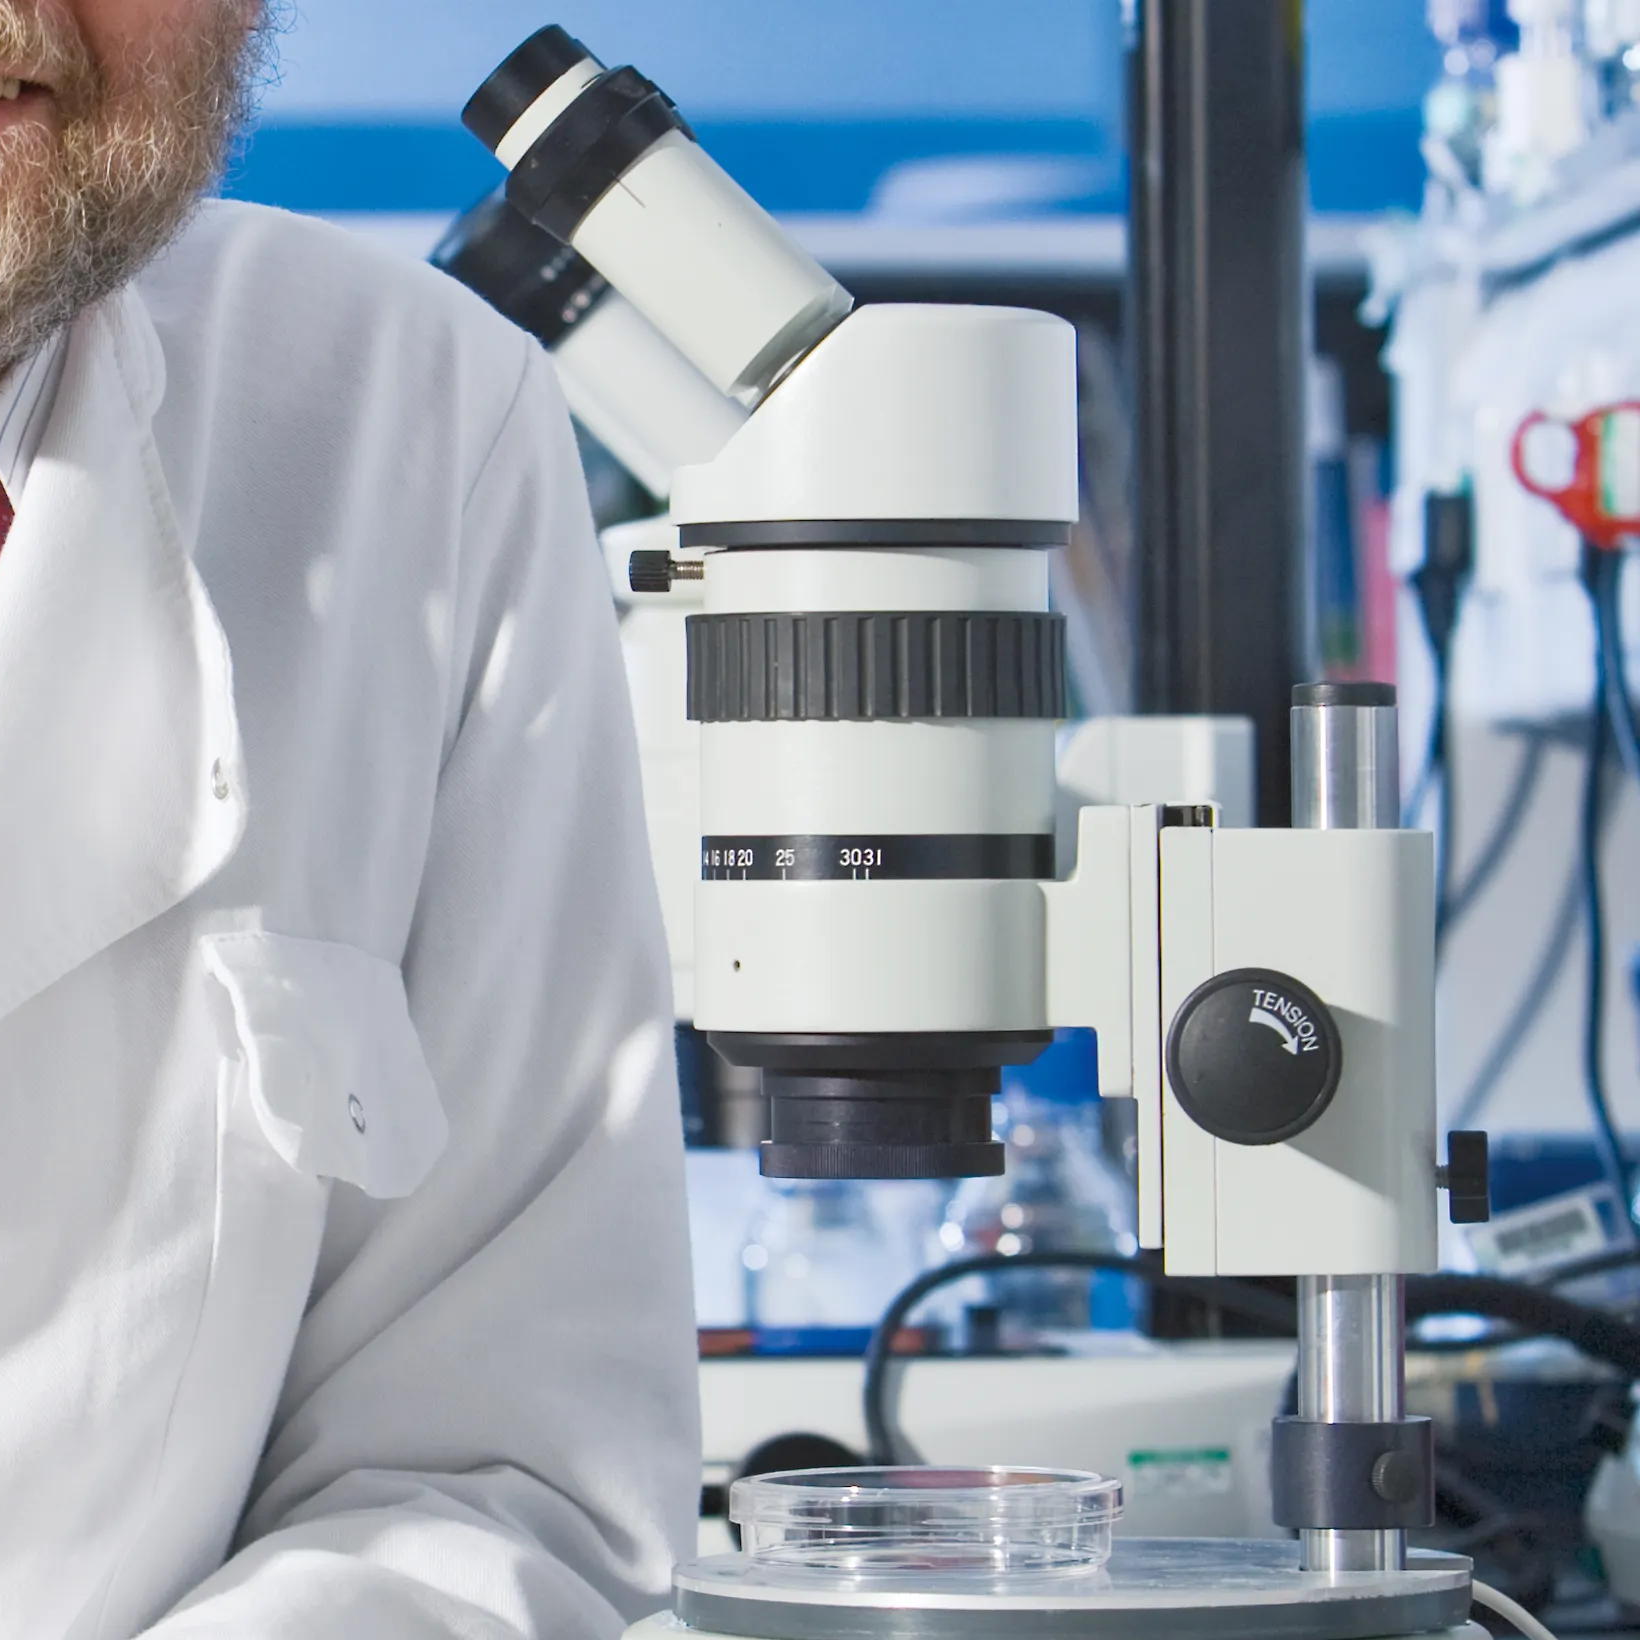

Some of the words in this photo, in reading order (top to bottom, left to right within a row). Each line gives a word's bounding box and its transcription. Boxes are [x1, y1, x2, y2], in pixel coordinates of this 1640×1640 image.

[711, 849, 721, 867] 16
[724, 849, 736, 867] 18
[737, 848, 753, 867] 20
[775, 848, 795, 867] 25
[839, 848, 862, 866] 30
[863, 848, 882, 866] 31
[1252, 988, 1320, 1053] TENSION
